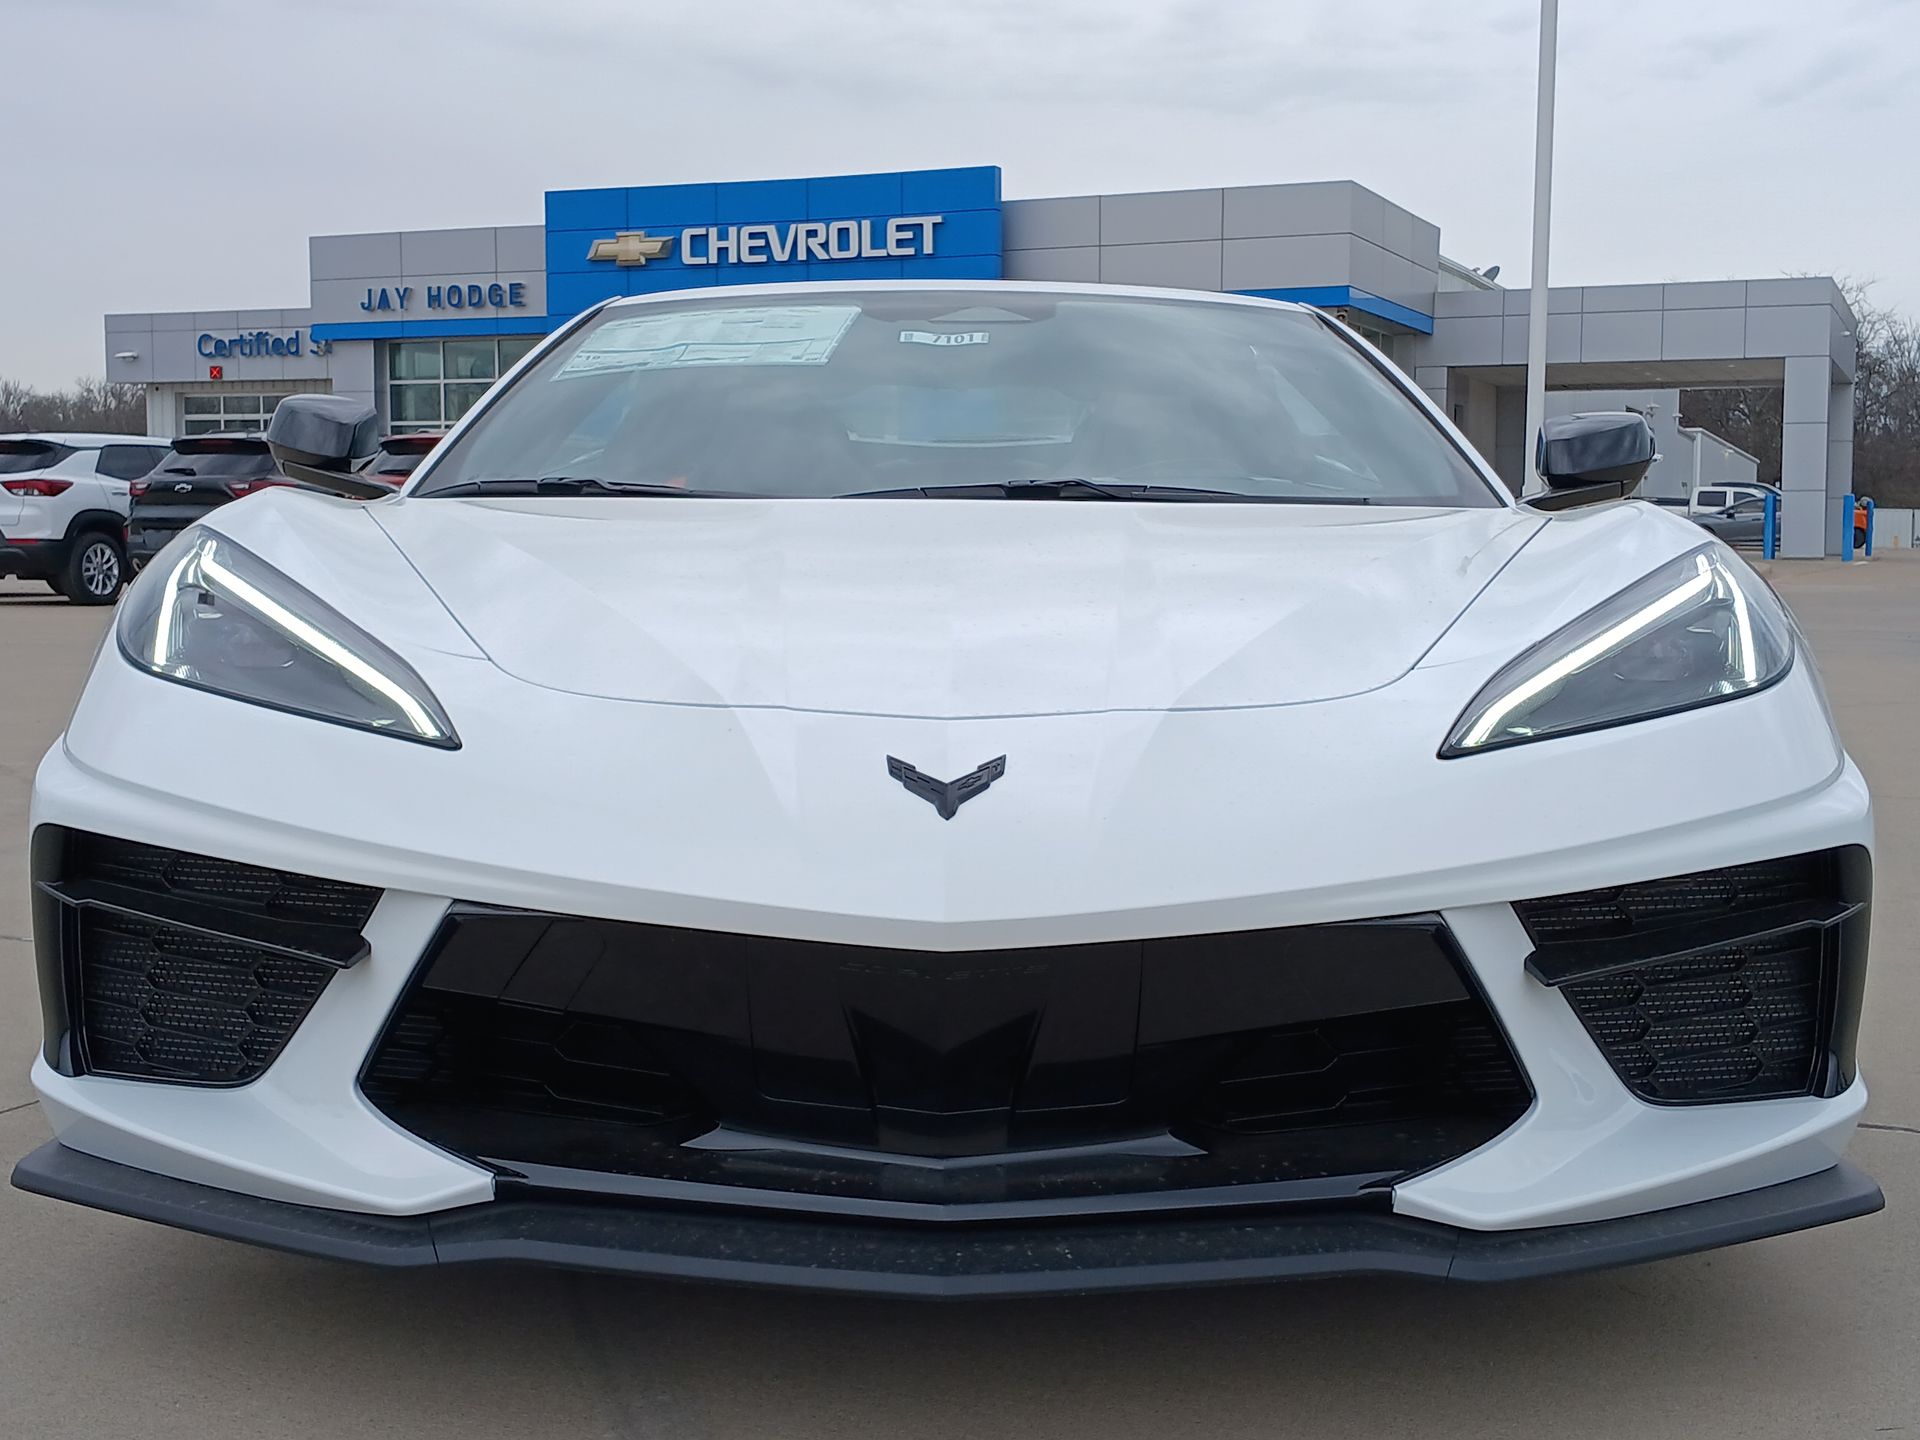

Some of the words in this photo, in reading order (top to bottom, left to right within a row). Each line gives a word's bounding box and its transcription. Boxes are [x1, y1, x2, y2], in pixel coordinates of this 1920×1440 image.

[681, 215, 943, 265] CHEVROLET
[360, 287, 412, 312] JAY
[427, 282, 527, 310] HODGE
[198, 330, 300, 357] Certified
[932, 333, 975, 345] 7101
